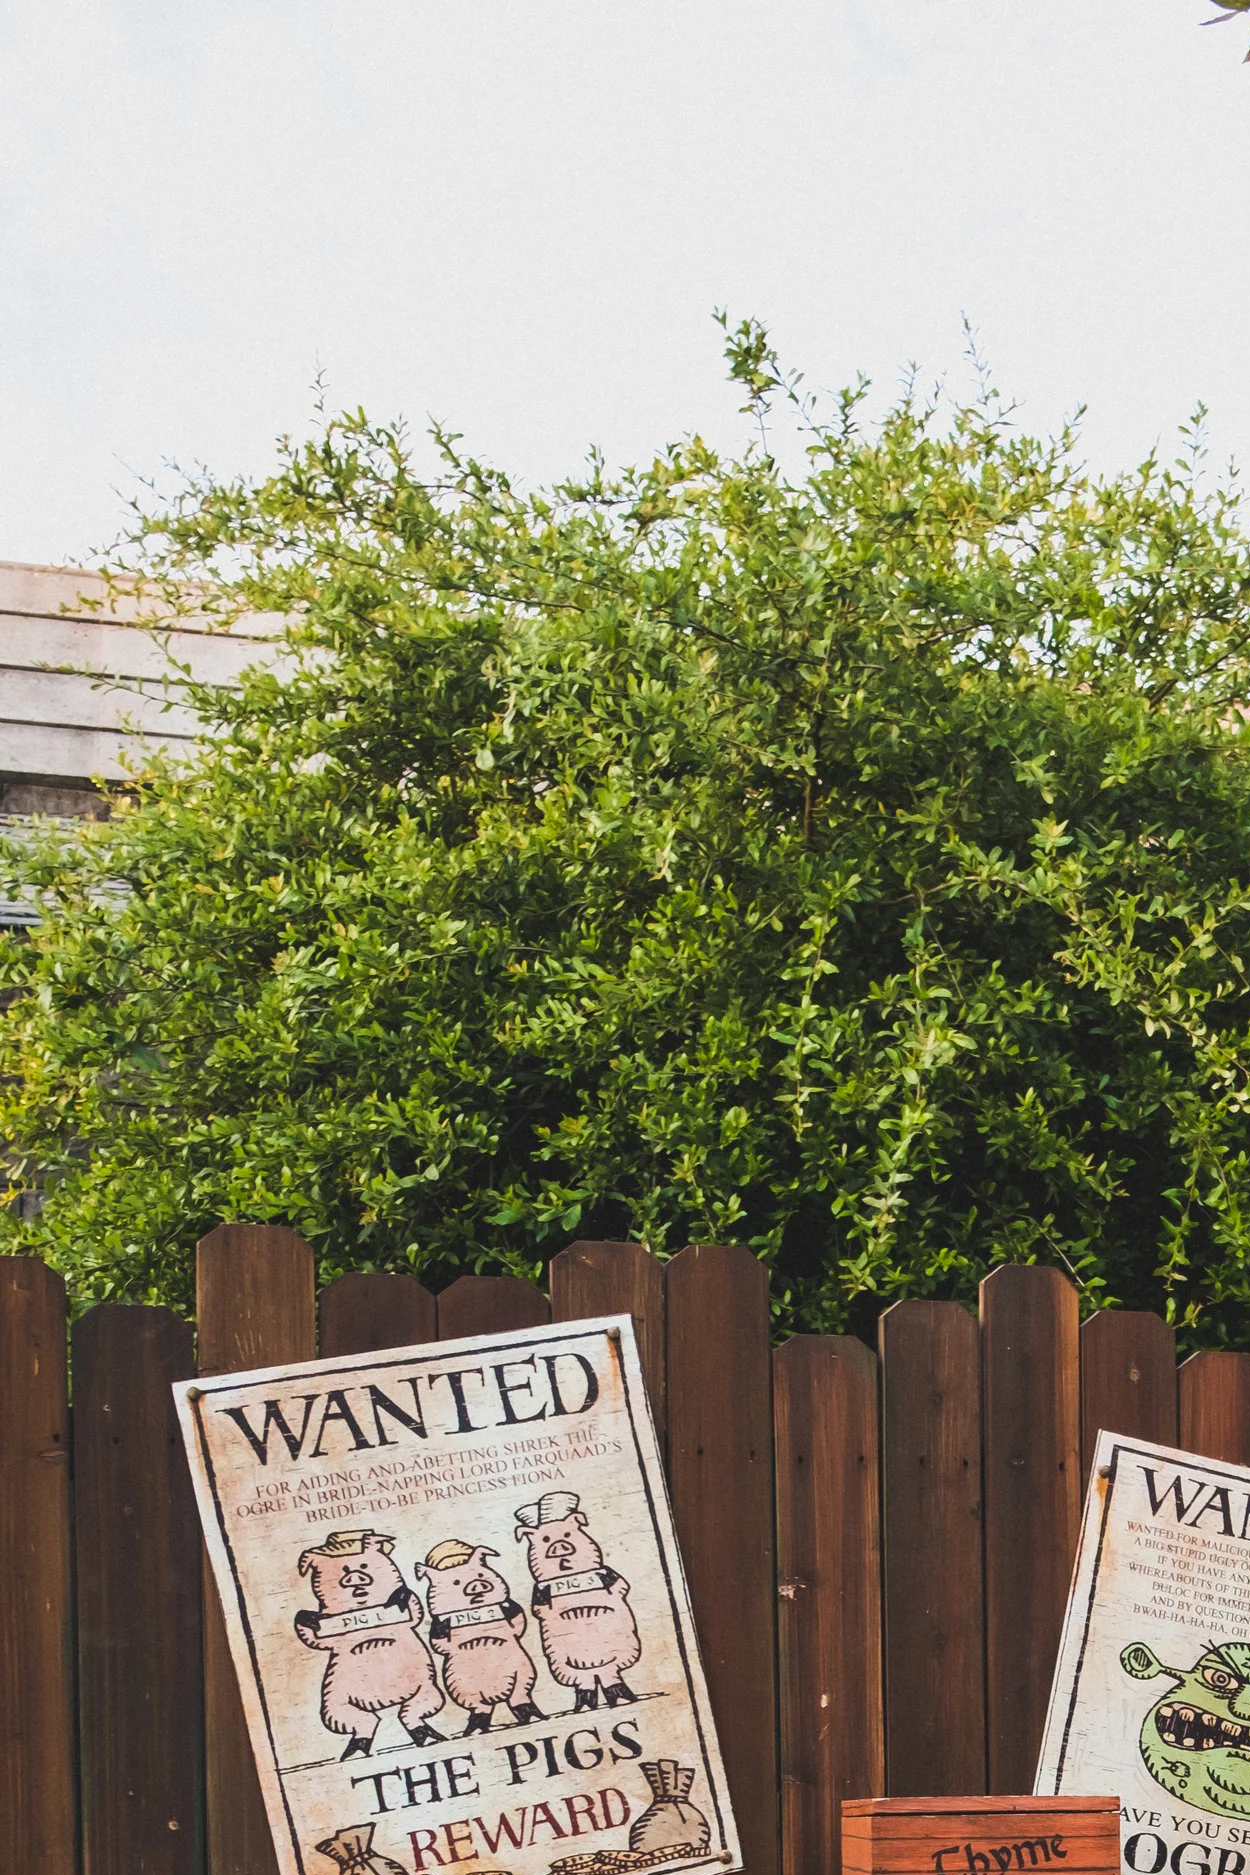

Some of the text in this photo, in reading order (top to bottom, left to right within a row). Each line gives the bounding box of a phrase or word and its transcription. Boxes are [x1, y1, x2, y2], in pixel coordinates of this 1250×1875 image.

[222, 1352, 601, 1467] WANTED
[236, 1439, 624, 1519] OGRE IN BRIDE-NAPPING LORD FARQUAAD'S
[255, 1426, 600, 1500] FOR AIDING AND ABETTING SHREK THE
[305, 1467, 567, 1523] BRIDE-TO-BE PRINCESS FIONA
[1127, 1520, 1174, 1540] WANTED
[1176, 1532, 1199, 1546] FOR
[1134, 1536, 1143, 1547] A
[1144, 1538, 1165, 1551] BIG
[1166, 1543, 1207, 1562] STUPID
[1208, 1552, 1239, 1570] UGLY
[1157, 1554, 1168, 1566] IF
[1170, 1556, 1195, 1571] YOU
[1197, 1563, 1228, 1580] HAVE
[555, 1578, 582, 1593] PIG
[1128, 1560, 1213, 1591] WHEREABOUTS
[1214, 1581, 1231, 1594] OF
[1151, 1580, 1191, 1599] DULOC
[1192, 1590, 1215, 1605] FOR
[455, 1609, 498, 1625] PIG 2
[1149, 1594, 1175, 1608] AND
[1176, 1600, 1193, 1613] BY
[342, 1613, 369, 1628] PIG
[1230, 1626, 1248, 1638] OH
[350, 1718, 644, 1816] THE PIGS
[406, 1786, 632, 1873] REWARD
[1118, 1806, 1162, 1829] AVE
[1170, 1815, 1222, 1839] YOU
